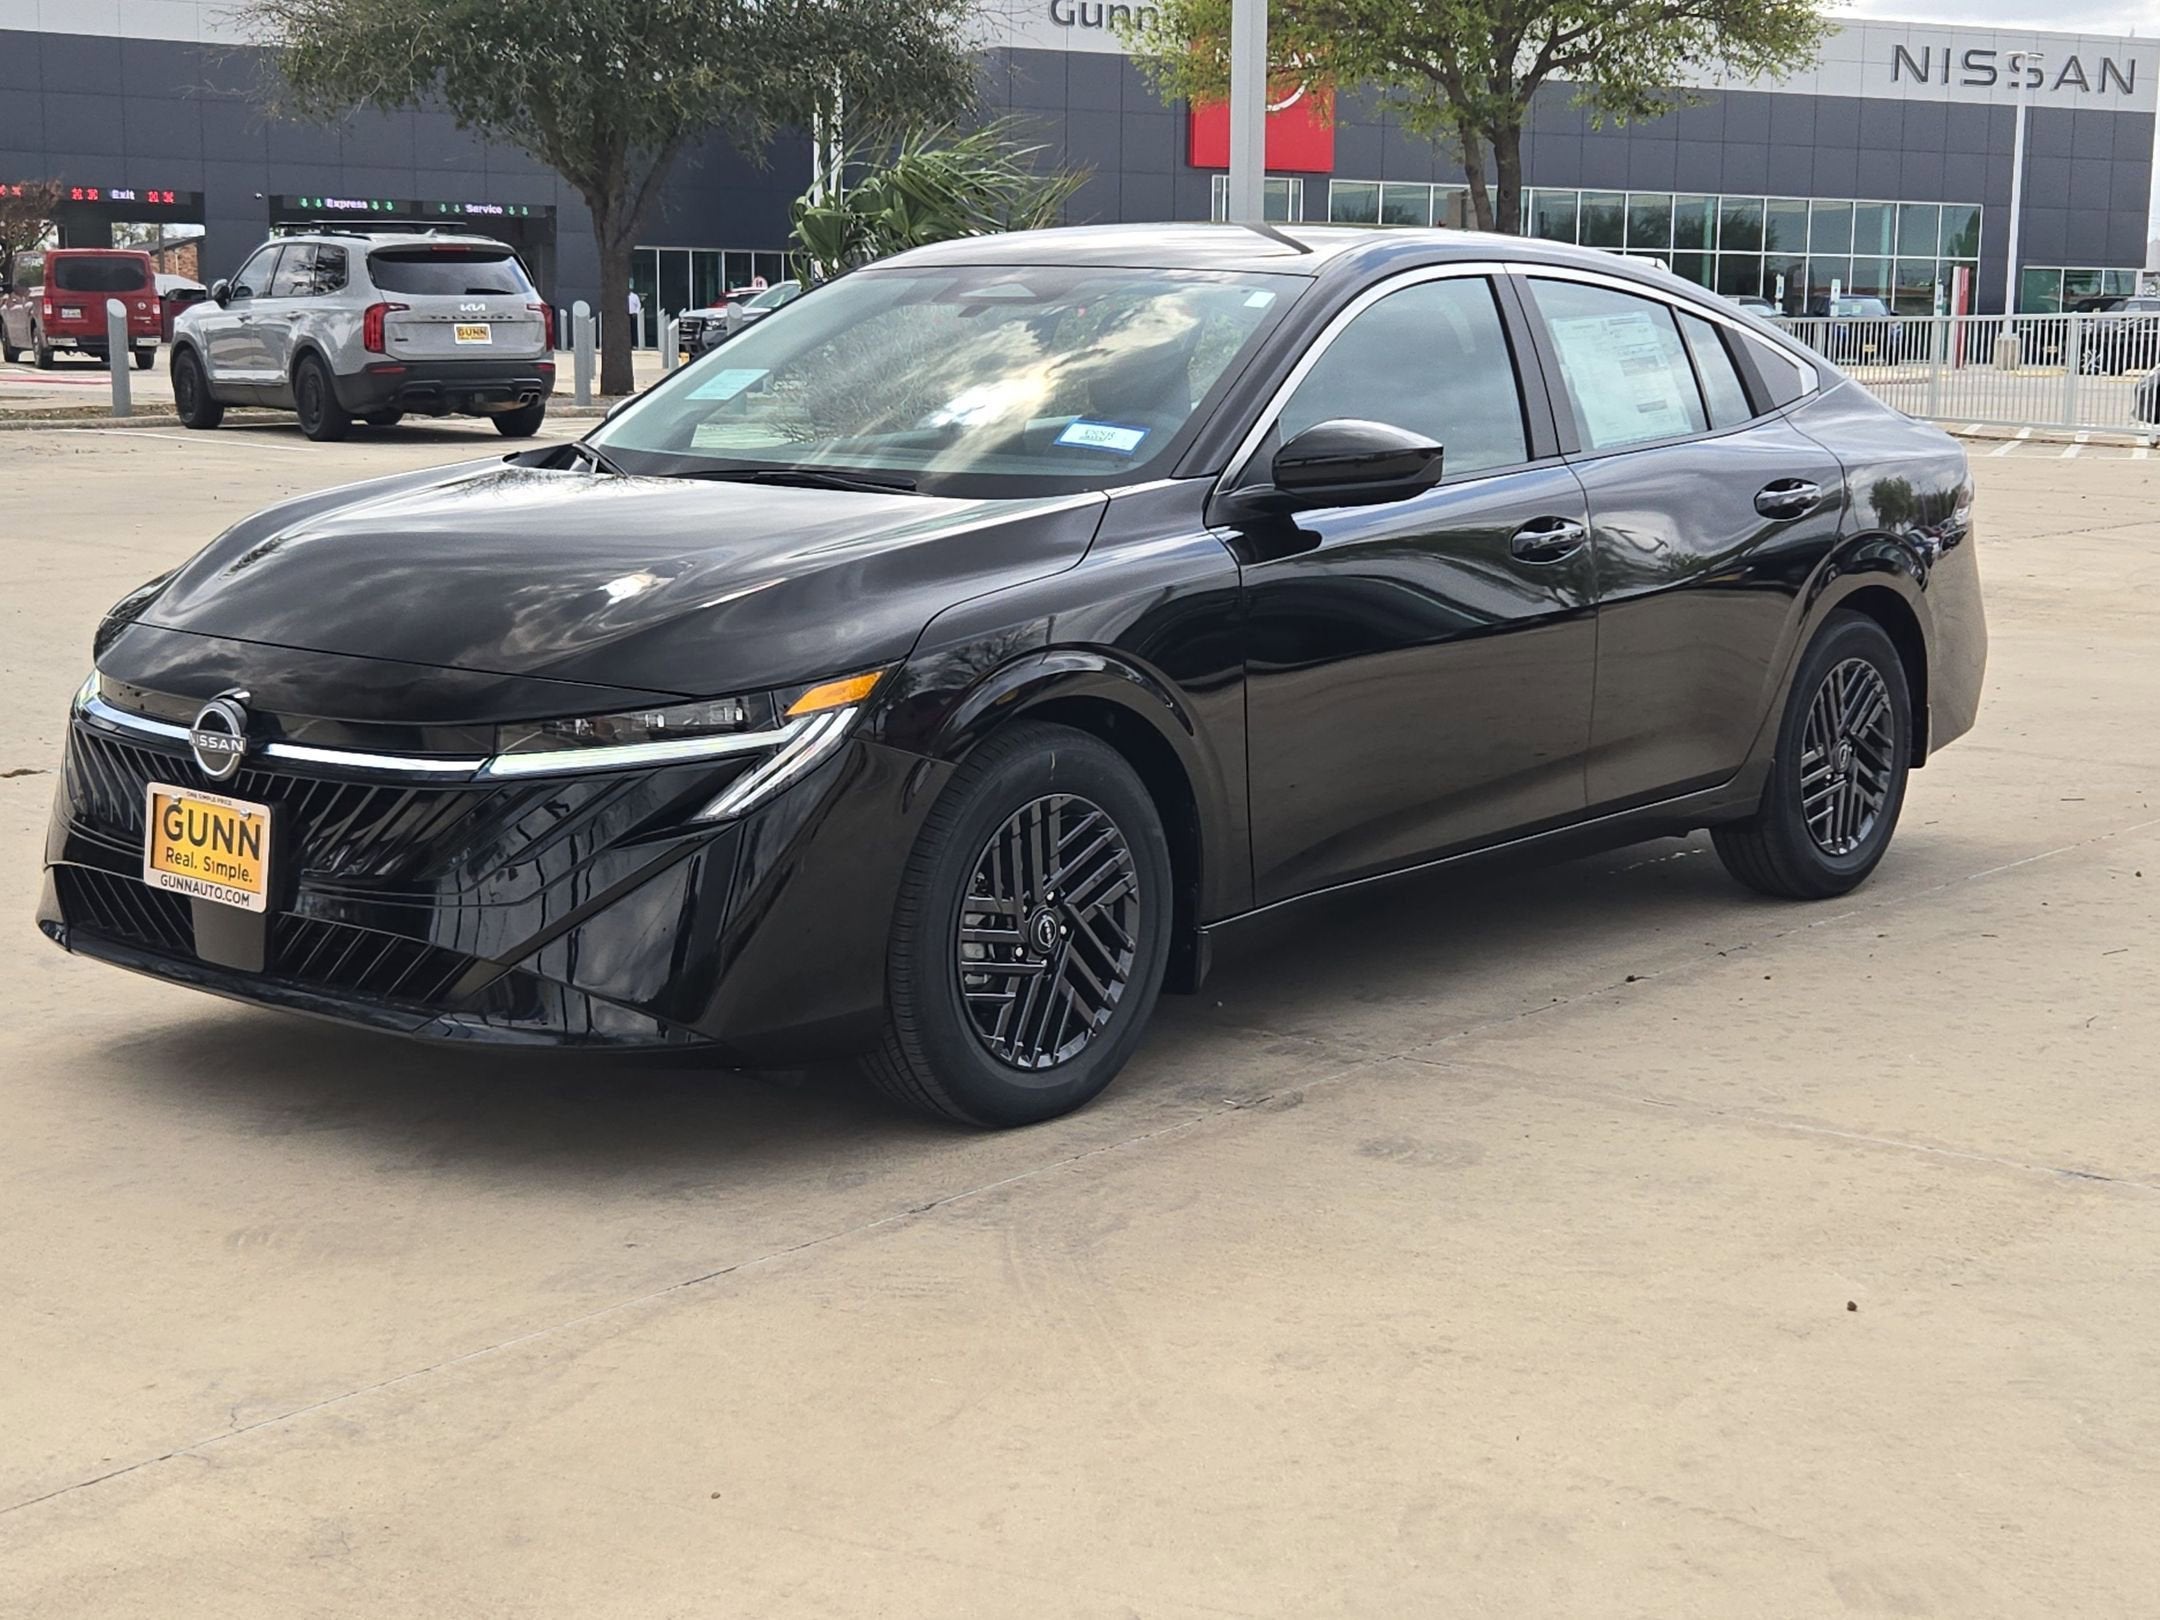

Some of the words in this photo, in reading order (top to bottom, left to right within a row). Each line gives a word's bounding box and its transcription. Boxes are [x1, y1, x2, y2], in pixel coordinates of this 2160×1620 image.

[1891, 44, 2136, 95] NISSAN
[111, 189, 135, 200] Exit
[325, 198, 368, 210] Express
[465, 204, 503, 214] Service
[460, 303, 486, 311] KIA
[458, 328, 487, 337] GUNN
[190, 732, 244, 752] NISSAN
[163, 803, 261, 861] GUNN
[165, 846, 197, 869] Real.
[160, 874, 250, 907] GUNNAUTO.COM
